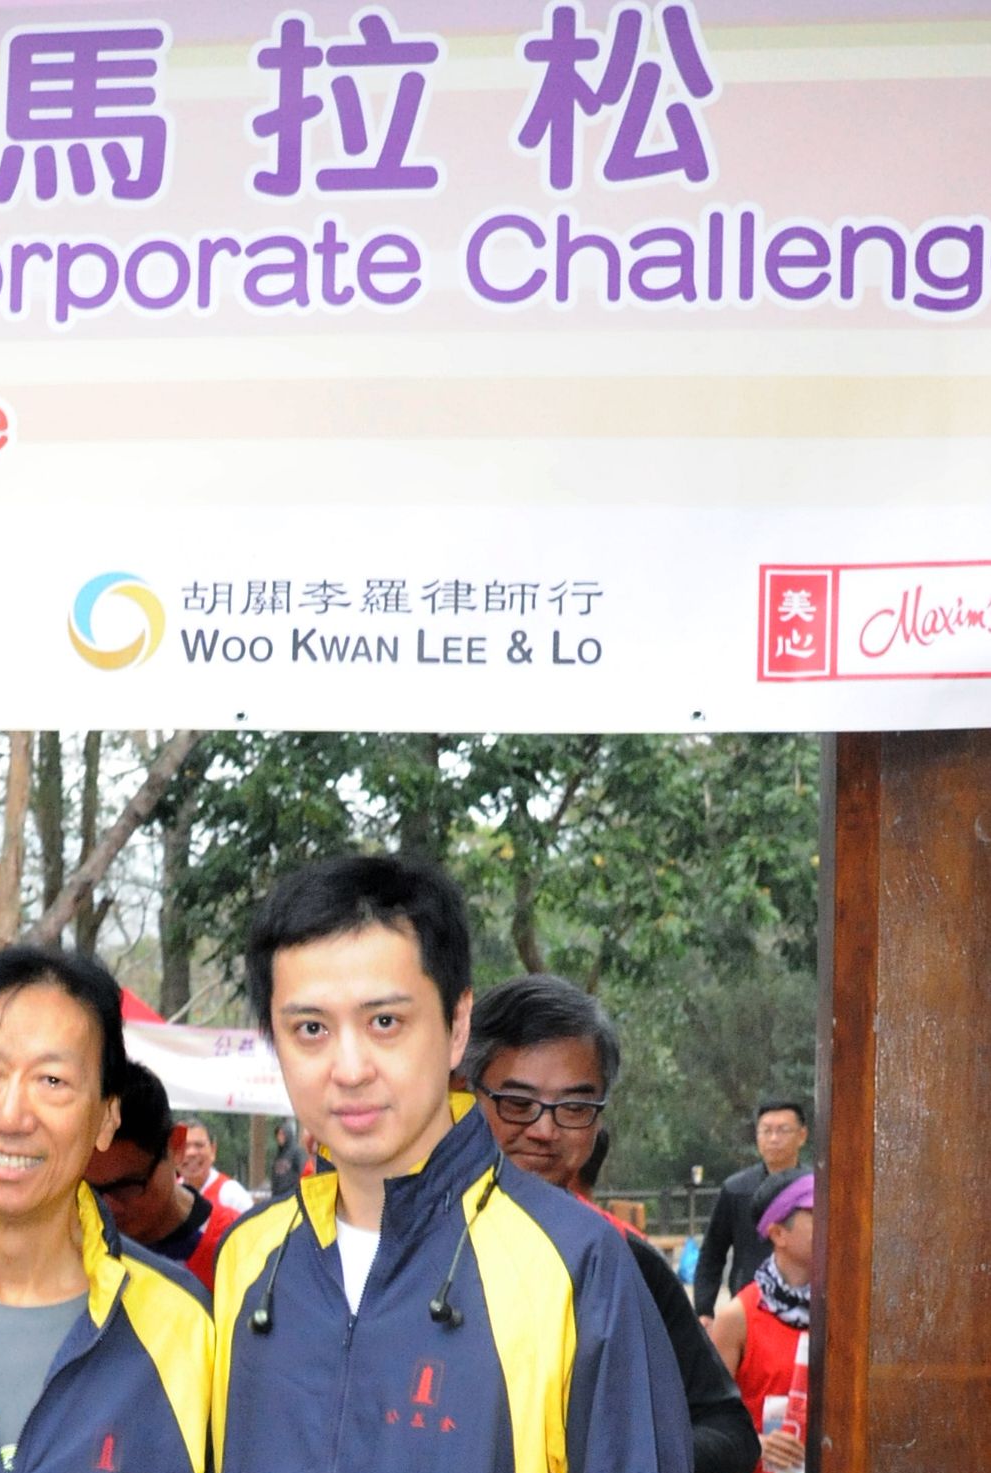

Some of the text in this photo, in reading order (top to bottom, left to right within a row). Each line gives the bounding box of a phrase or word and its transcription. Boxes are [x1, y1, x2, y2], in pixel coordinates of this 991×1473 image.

[466, 210, 985, 313] Challeng
[180, 577, 604, 616] 胡關李羅律師行
[775, 588, 817, 660] 美心
[859, 584, 991, 659] Maxim
[506, 629, 534, 666] &
